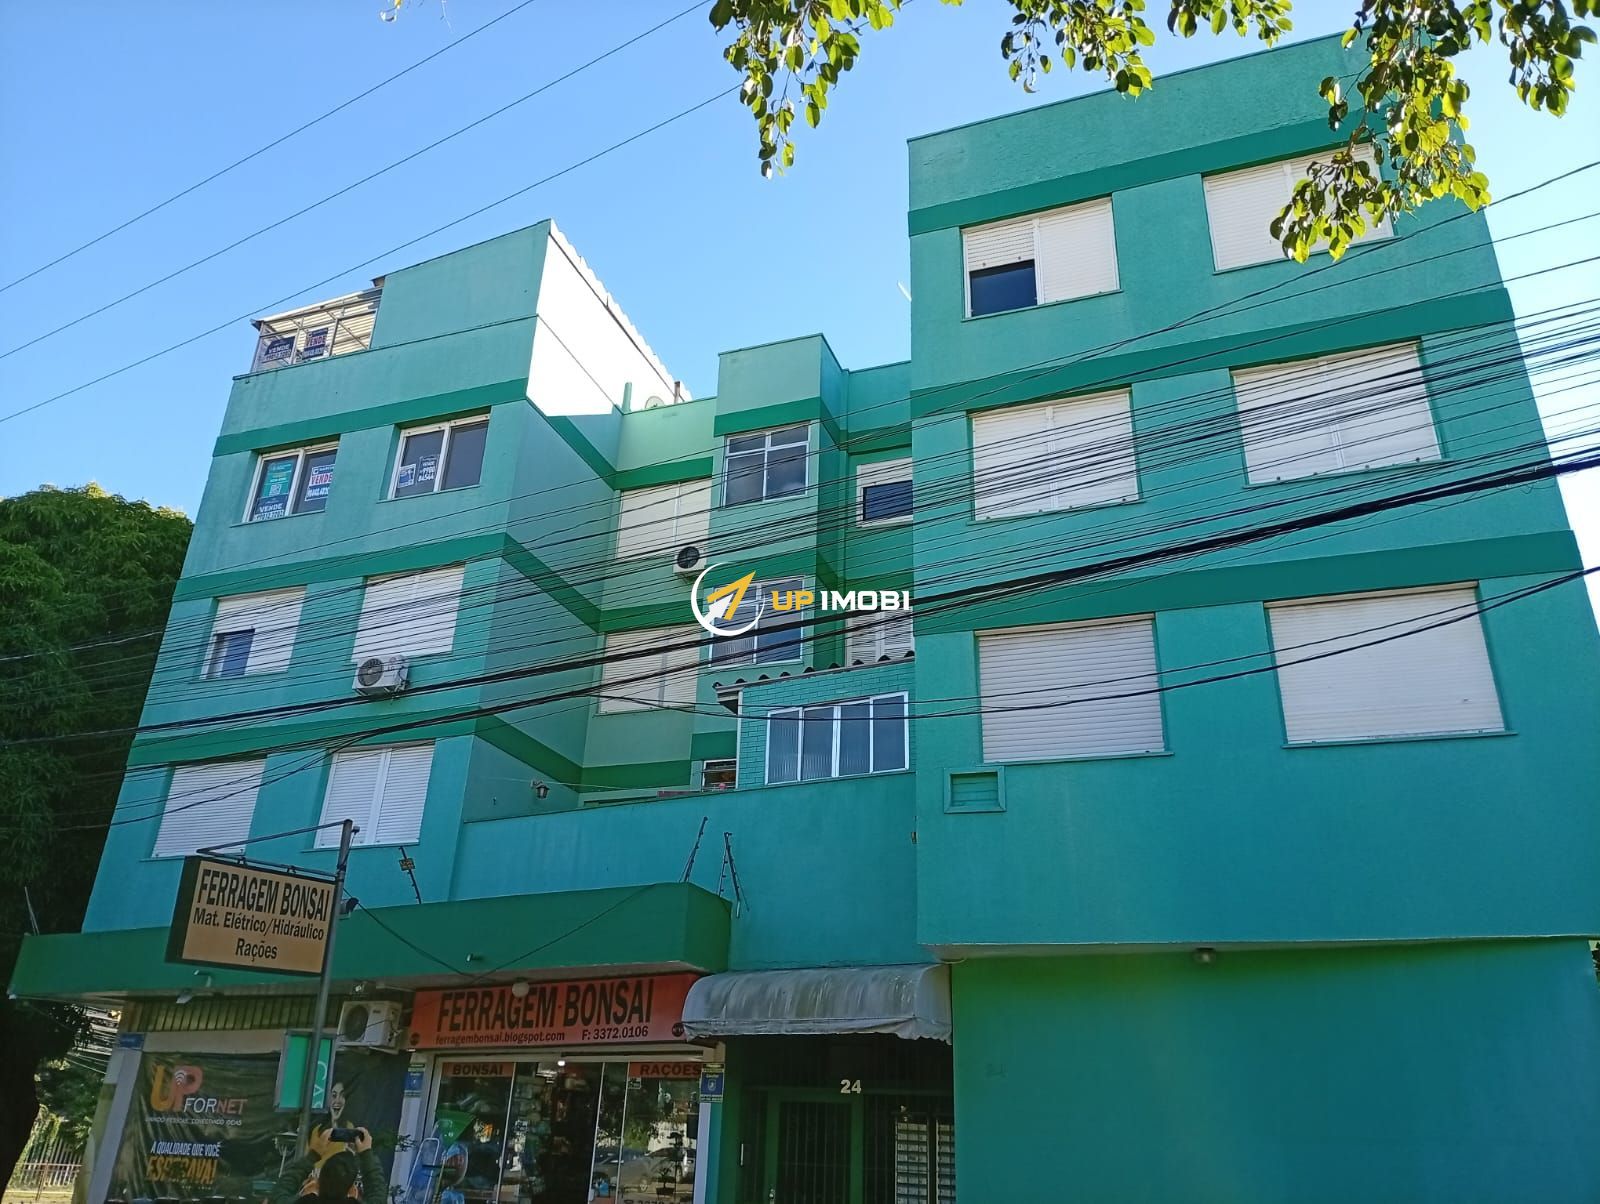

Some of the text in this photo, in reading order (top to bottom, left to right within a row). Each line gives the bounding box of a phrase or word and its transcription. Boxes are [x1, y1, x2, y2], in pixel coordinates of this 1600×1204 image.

[197, 869, 330, 922] FERRAGEM BONSAI
[193, 907, 324, 941] Mat. Elétrico/Hidráulico
[235, 937, 278, 962] Rações
[437, 978, 654, 1032] FERRAGEM BONSAI
[581, 1029, 591, 1041] F:
[593, 1026, 649, 1040] 3372.0106
[452, 1063, 504, 1076] BONSAI
[151, 1065, 203, 1112] UP
[840, 1079, 862, 1094] 24
[183, 1097, 248, 1115] FORNET
[150, 1141, 156, 1154] A
[157, 1141, 192, 1155] QUALIDADE
[192, 1142, 205, 1156] QUE
